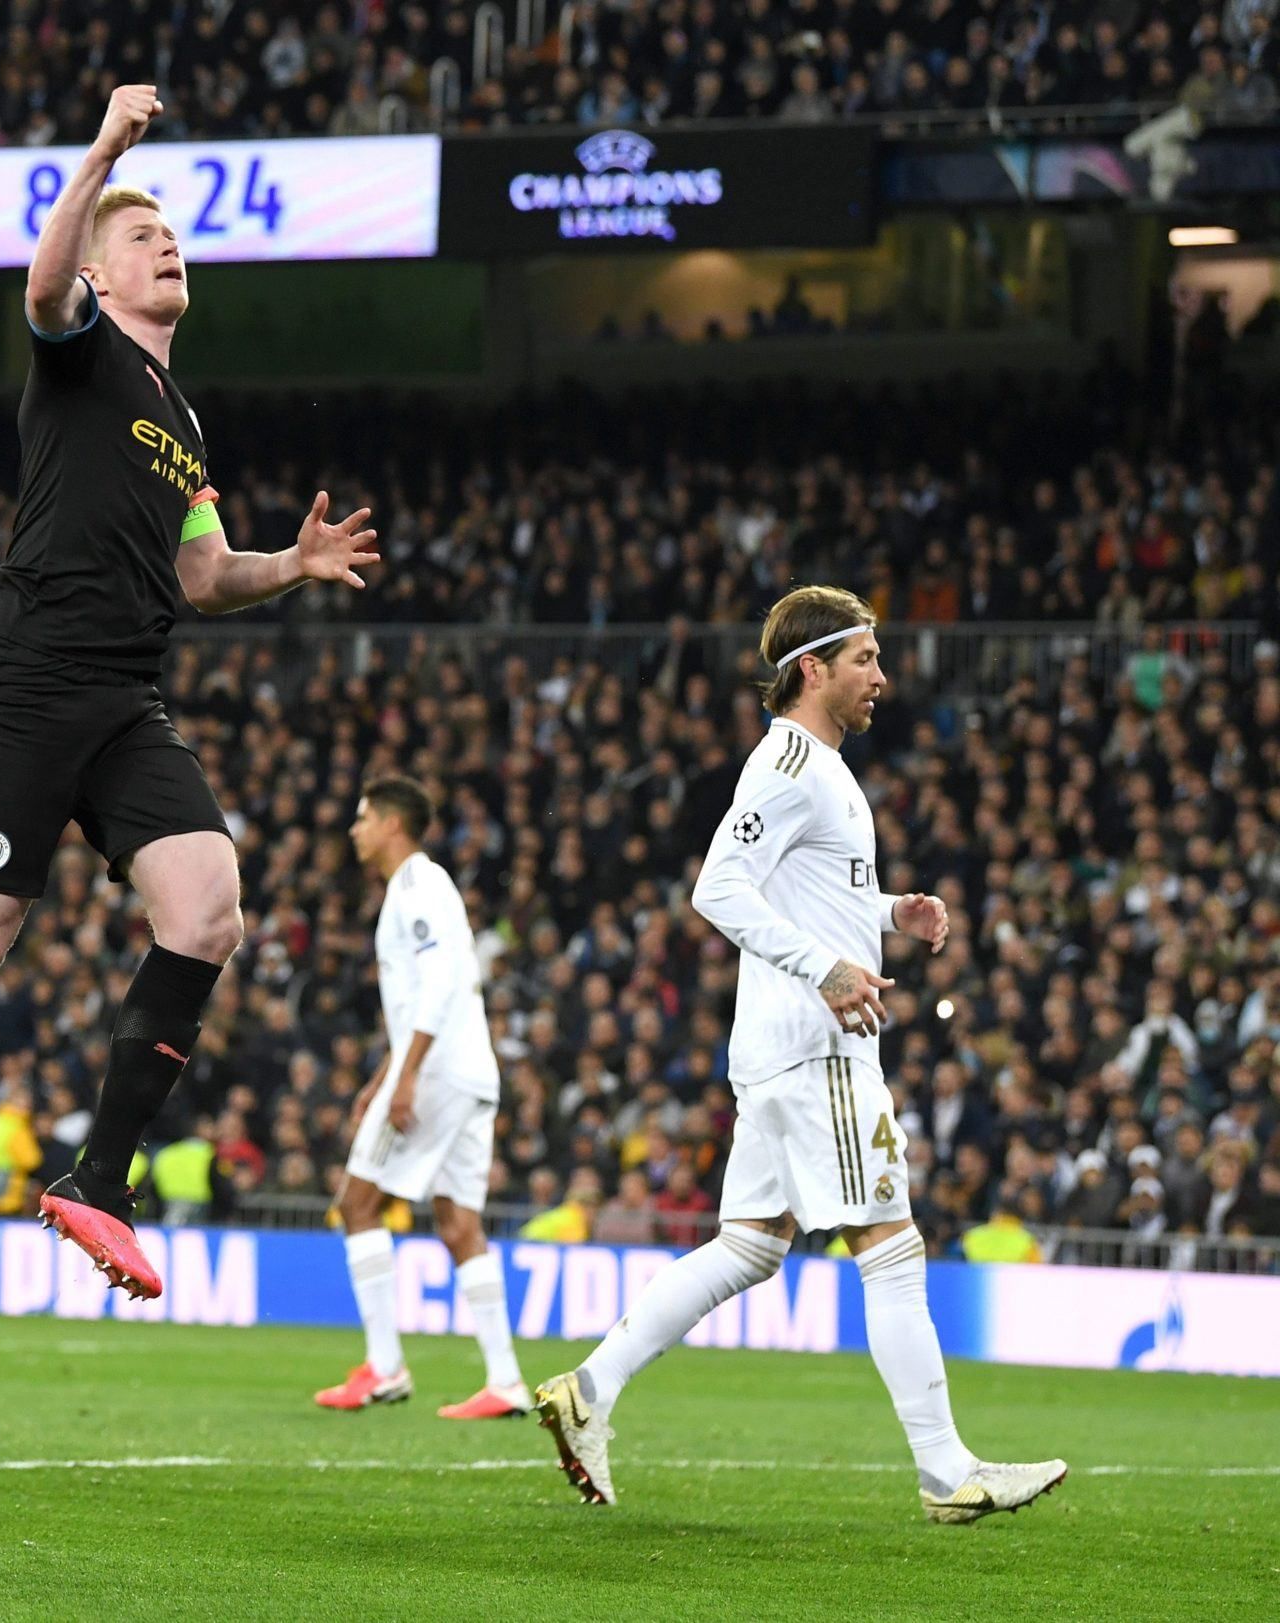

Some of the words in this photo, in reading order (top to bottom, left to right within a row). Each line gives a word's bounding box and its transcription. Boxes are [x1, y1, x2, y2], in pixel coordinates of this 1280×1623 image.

[510, 168, 723, 211] CHAMPIONS
[131, 419, 205, 488] ETIHA
[871, 1112, 898, 1165] 4
